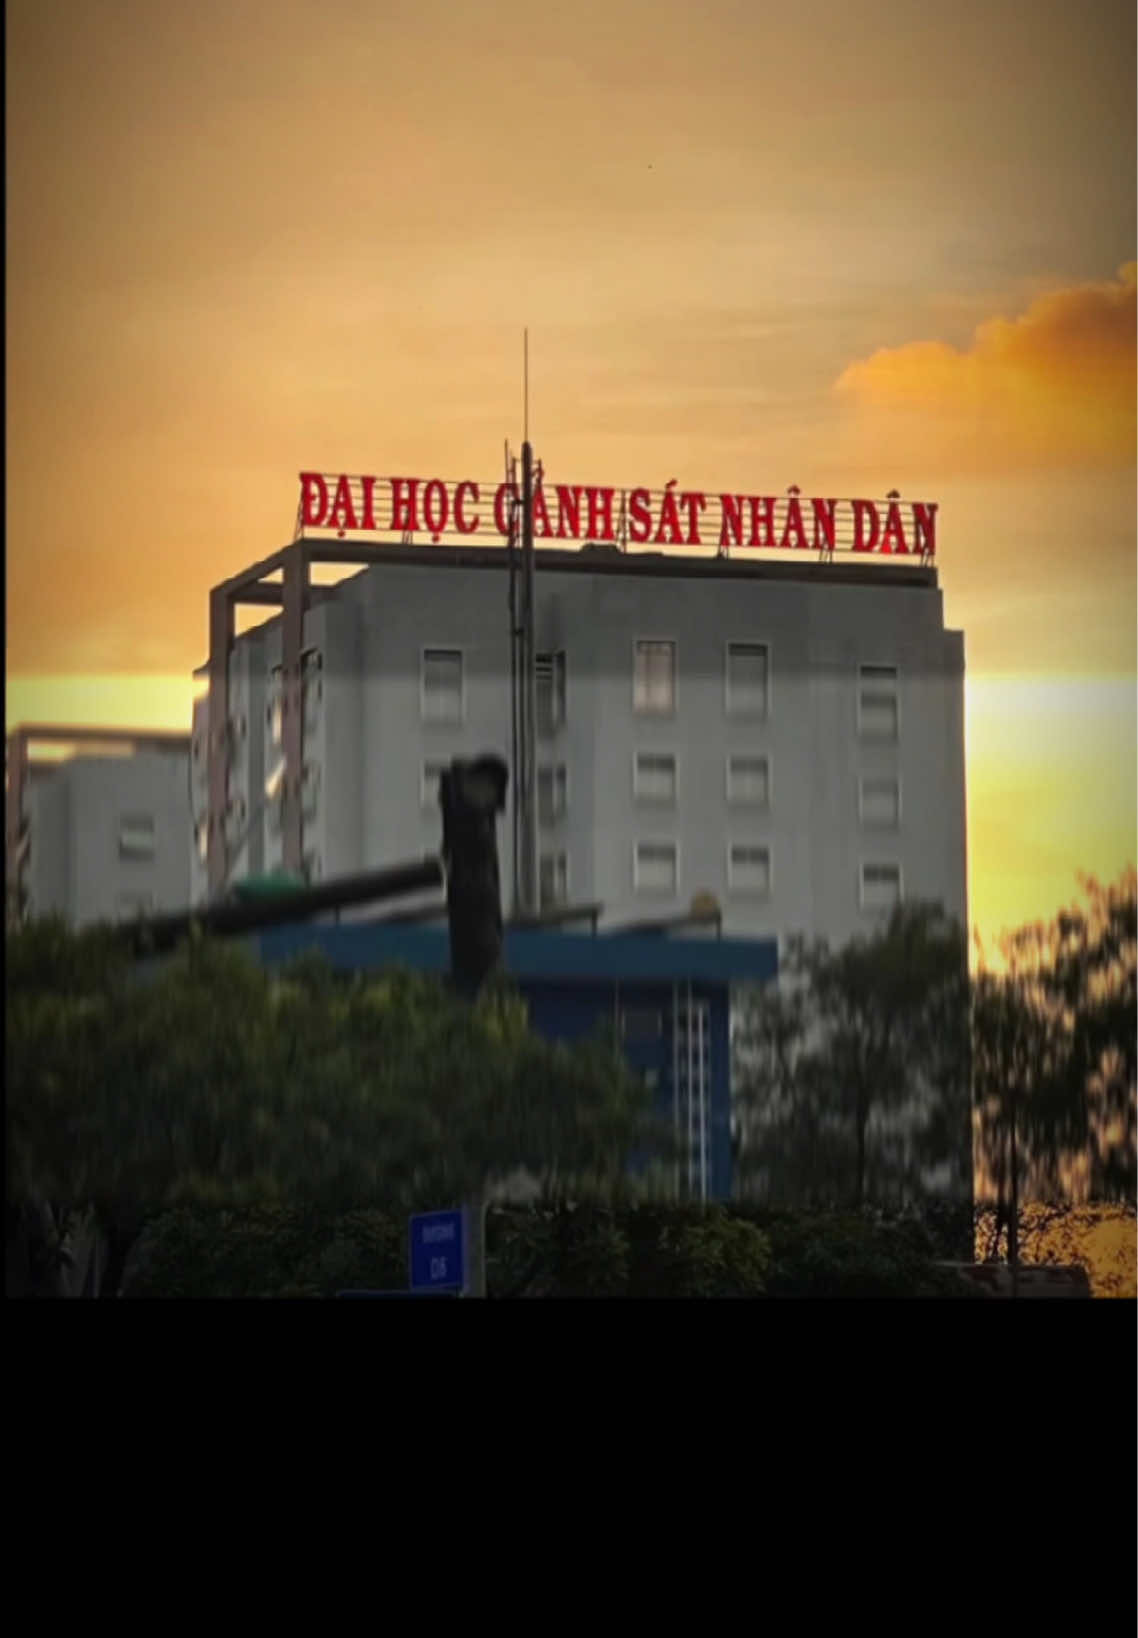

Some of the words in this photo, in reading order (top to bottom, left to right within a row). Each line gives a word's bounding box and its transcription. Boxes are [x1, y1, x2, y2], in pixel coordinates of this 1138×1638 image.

[300, 472, 376, 538] ĐẠI
[390, 477, 479, 542] HỌC
[629, 478, 706, 544] SÁT
[720, 484, 838, 550] NHÂN
[851, 489, 939, 555] DÂN
